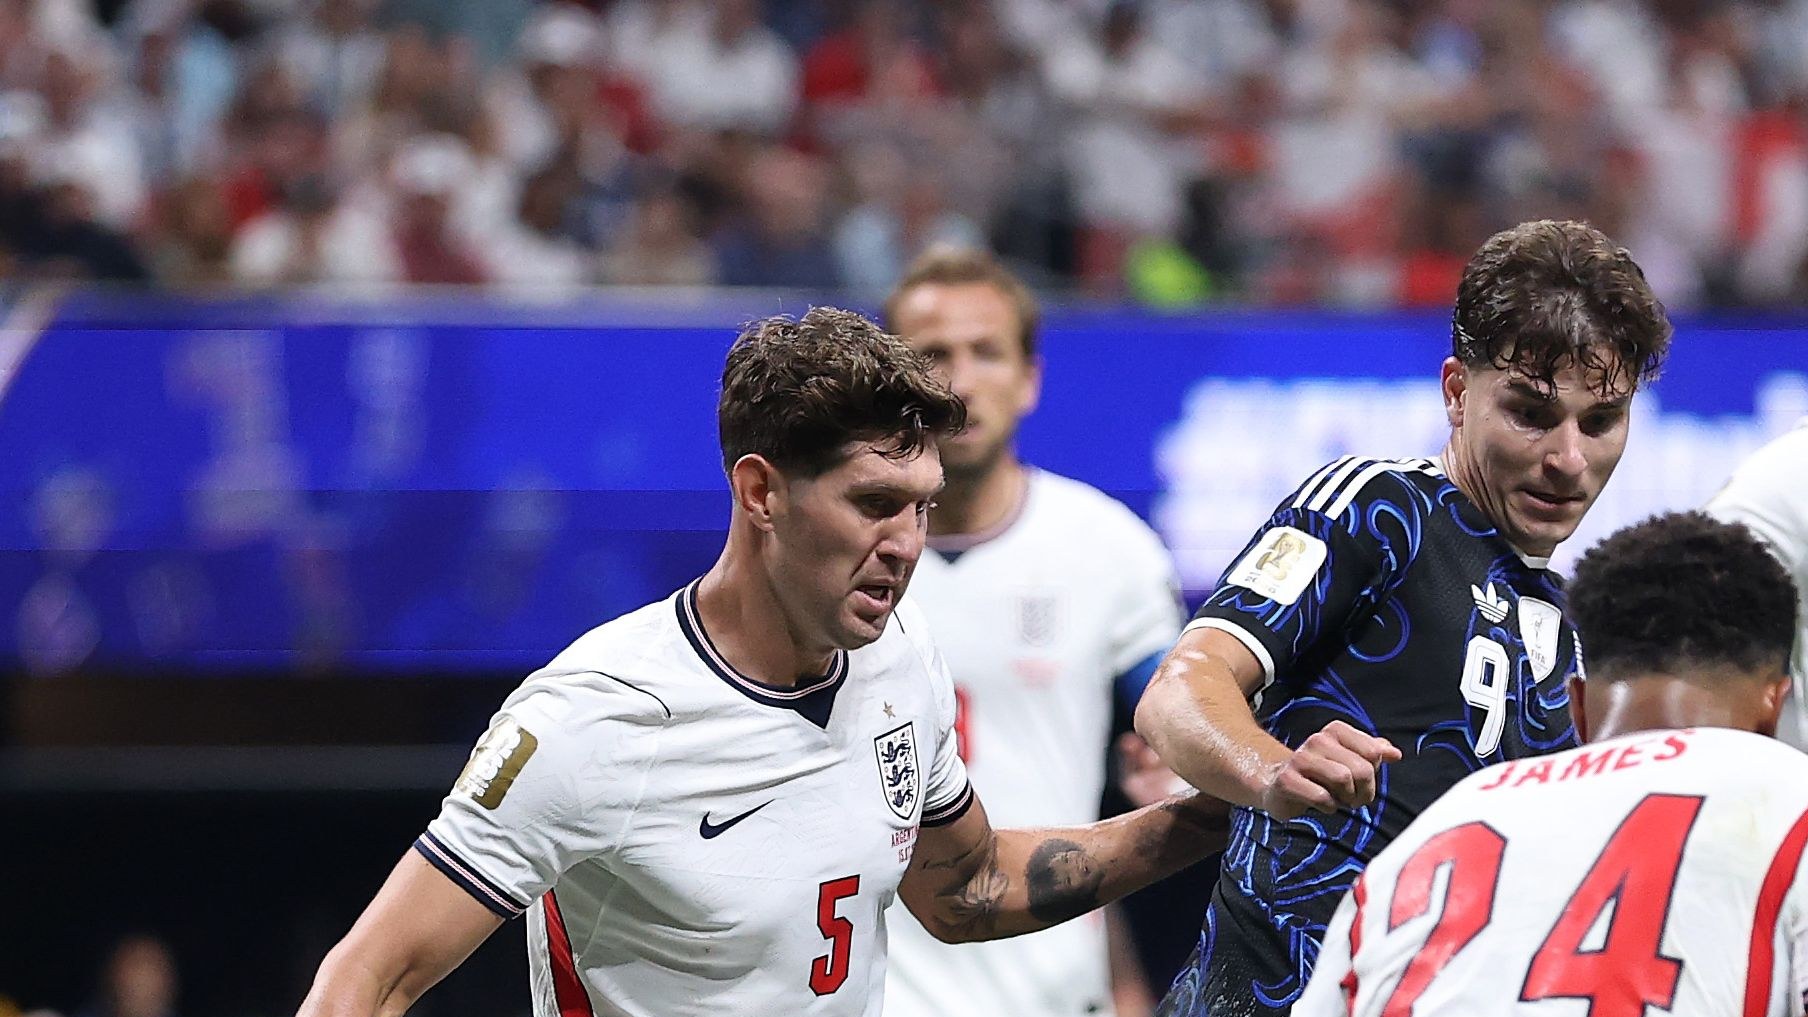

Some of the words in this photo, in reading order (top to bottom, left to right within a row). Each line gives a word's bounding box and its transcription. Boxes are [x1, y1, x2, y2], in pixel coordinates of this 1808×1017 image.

[1459, 634, 1510, 758] 9
[1478, 728, 1696, 790] JAMES
[808, 874, 860, 997] 5
